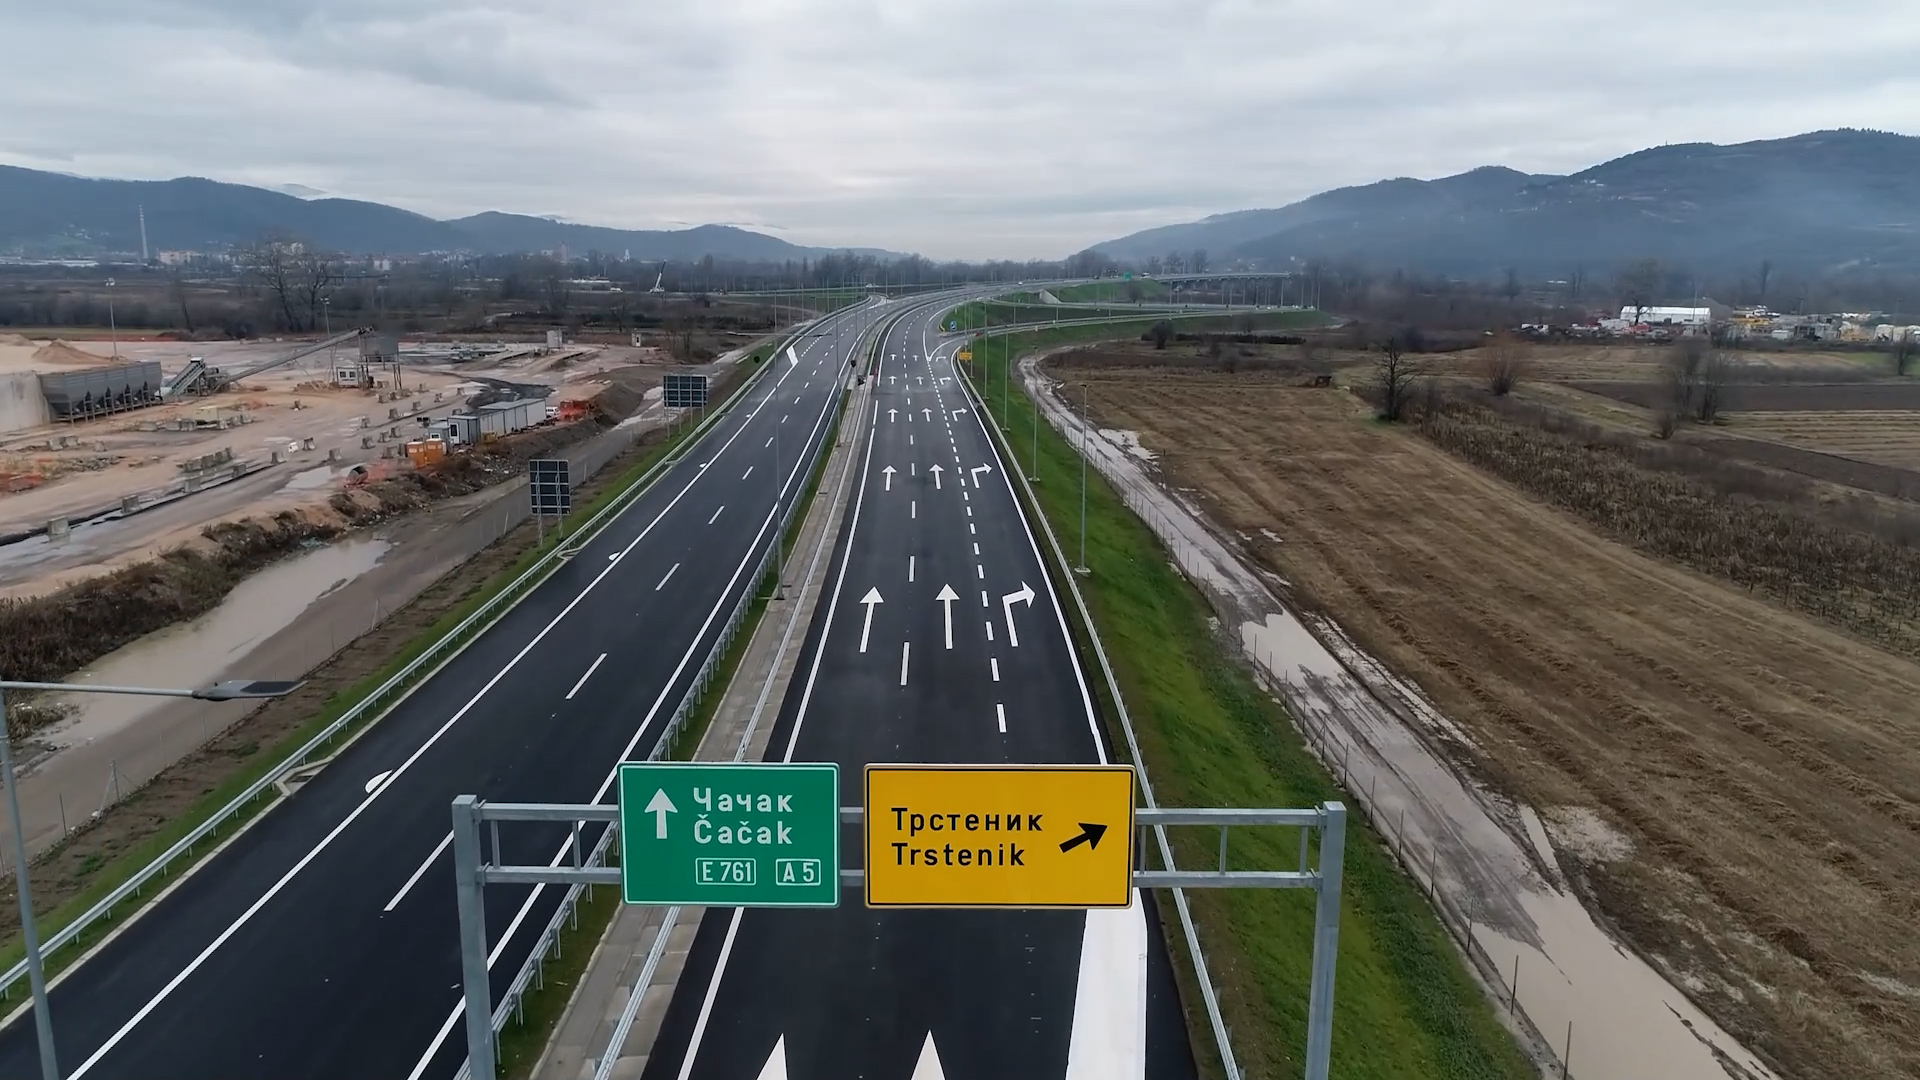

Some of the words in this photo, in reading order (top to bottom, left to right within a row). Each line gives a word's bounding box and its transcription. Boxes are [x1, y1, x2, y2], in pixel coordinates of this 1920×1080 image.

[694, 788, 792, 812] Чачак
[694, 815, 792, 844] Čačak
[891, 808, 1042, 837] Трстеник
[892, 843, 1025, 867] Trstenik
[702, 862, 713, 882] E
[720, 862, 751, 882] 761
[782, 863, 796, 882] A
[803, 862, 815, 882] 5
